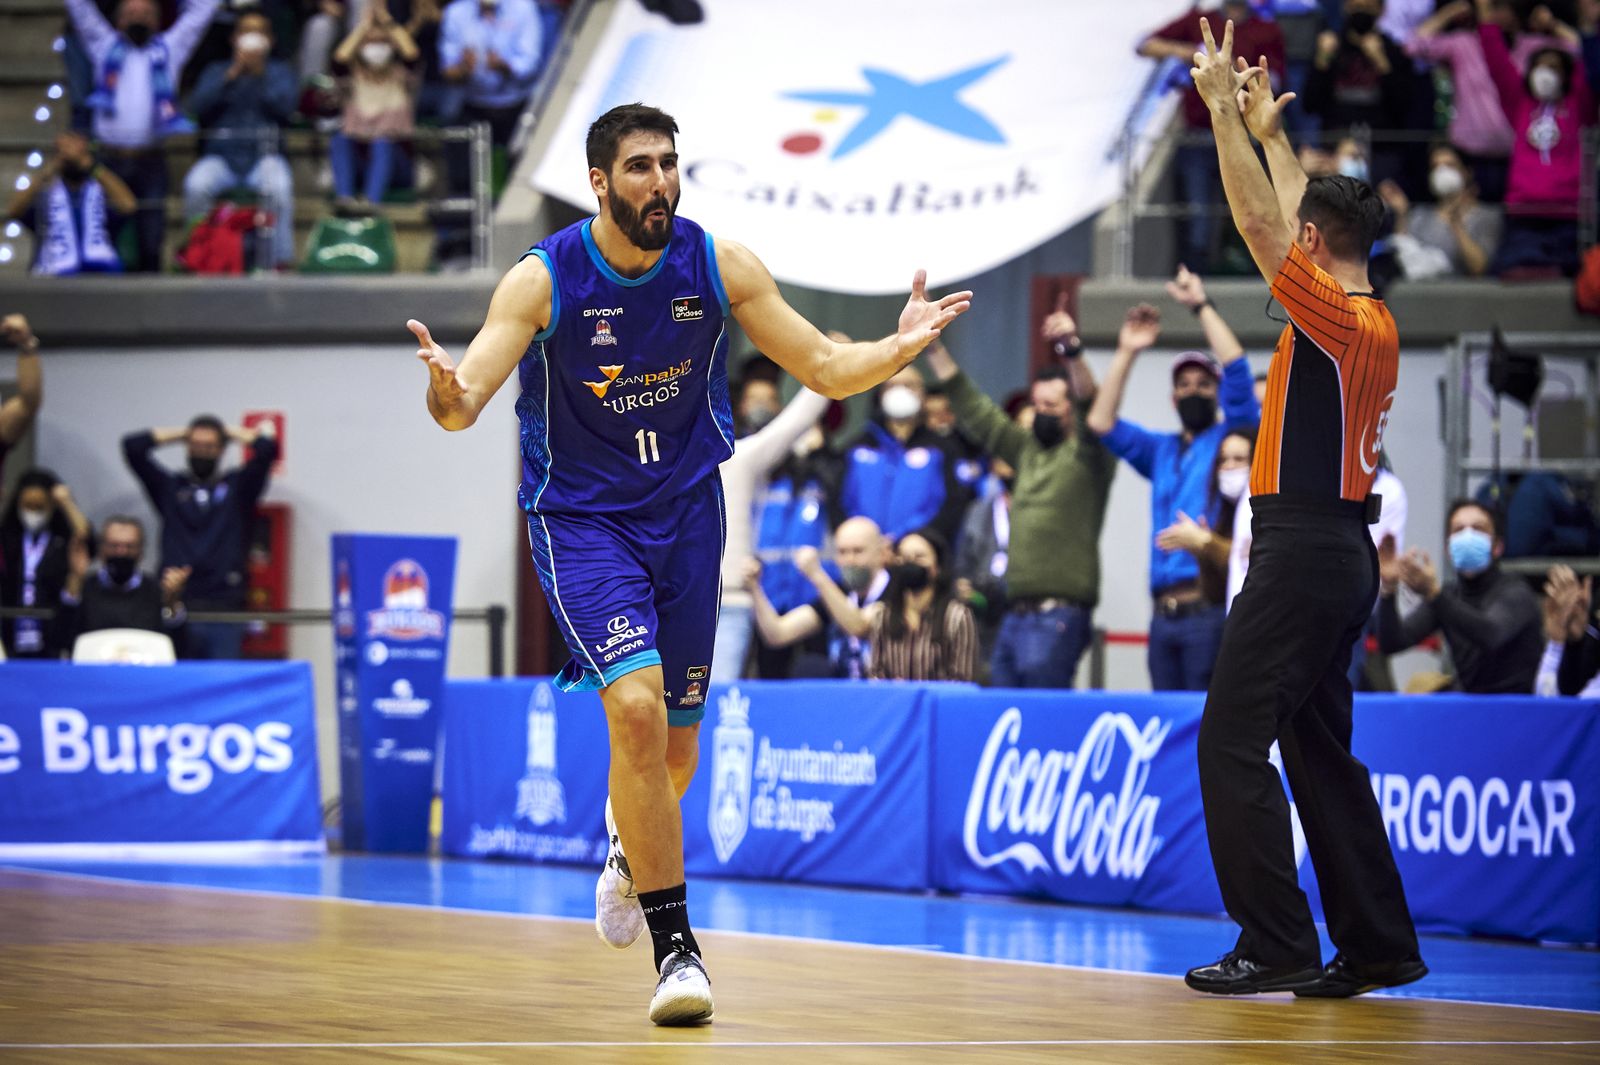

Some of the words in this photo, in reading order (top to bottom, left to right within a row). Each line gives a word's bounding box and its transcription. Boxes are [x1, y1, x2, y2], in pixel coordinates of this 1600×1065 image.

[684, 157, 1038, 216] CaixaBank
[583, 307, 624, 317] GIVOVA
[603, 381, 680, 414] URGOS
[635, 428, 660, 464] 11
[596, 626, 648, 652] LEXUS
[604, 639, 645, 662] GIVOVA
[40, 707, 294, 793] Burgos
